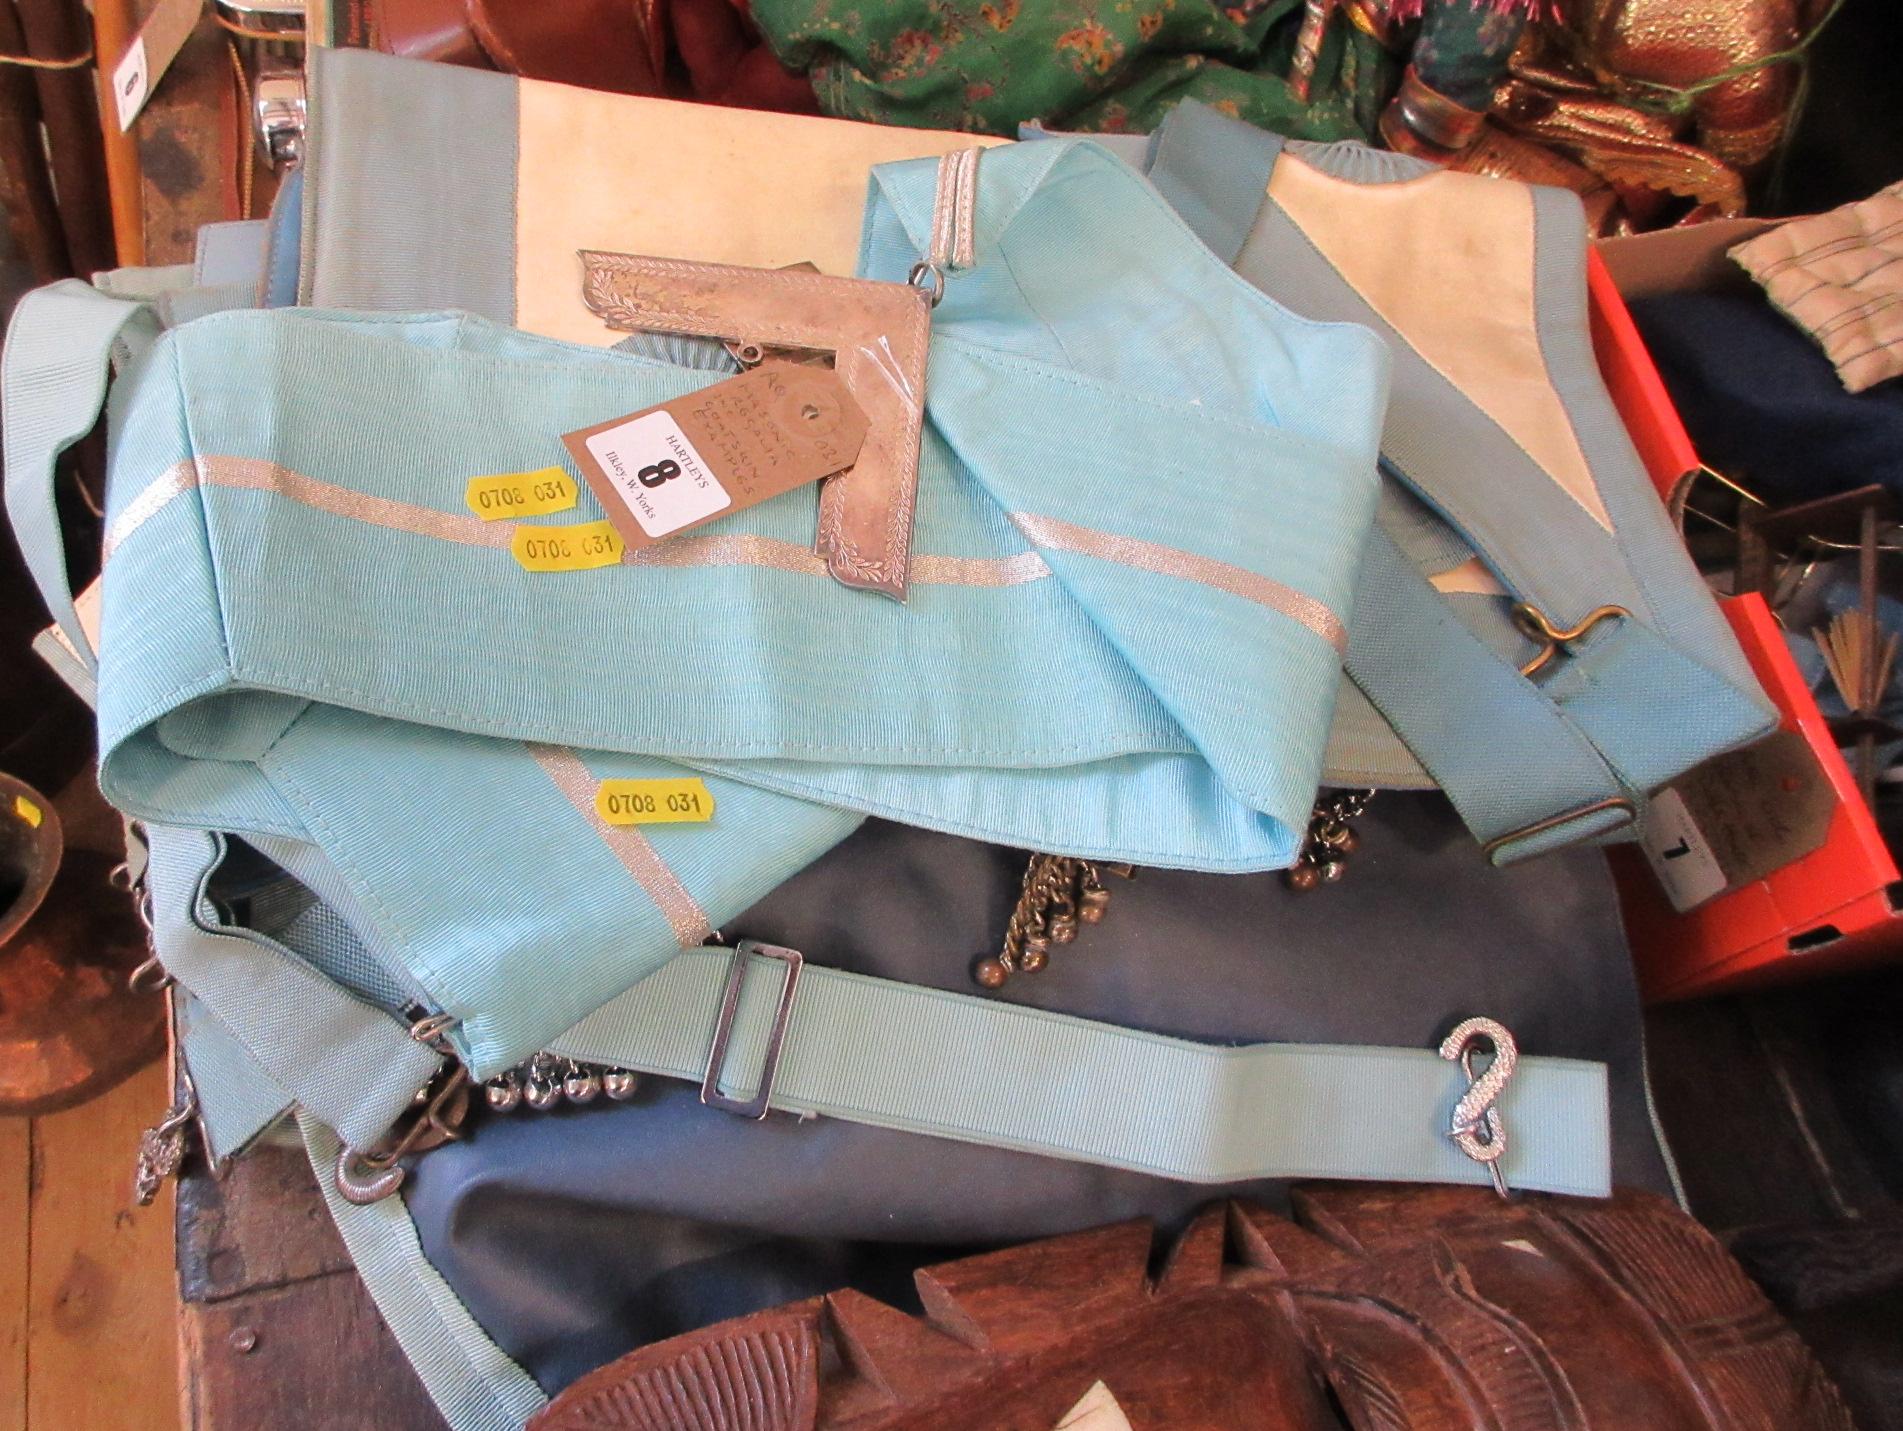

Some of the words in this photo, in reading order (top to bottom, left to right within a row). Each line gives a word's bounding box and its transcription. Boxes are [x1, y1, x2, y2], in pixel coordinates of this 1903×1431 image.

[738, 383, 795, 460] MASONIC
[637, 458, 682, 489] 8
[666, 435, 710, 489] HARTLEYS
[693, 407, 755, 496] EXAMPLES
[479, 487, 525, 509] 0708
[534, 481, 566, 502] 031
[606, 451, 628, 484] Ilkley,
[634, 493, 657, 520] Yorks
[608, 794, 656, 814] 0708
[667, 793, 702, 814] 031
